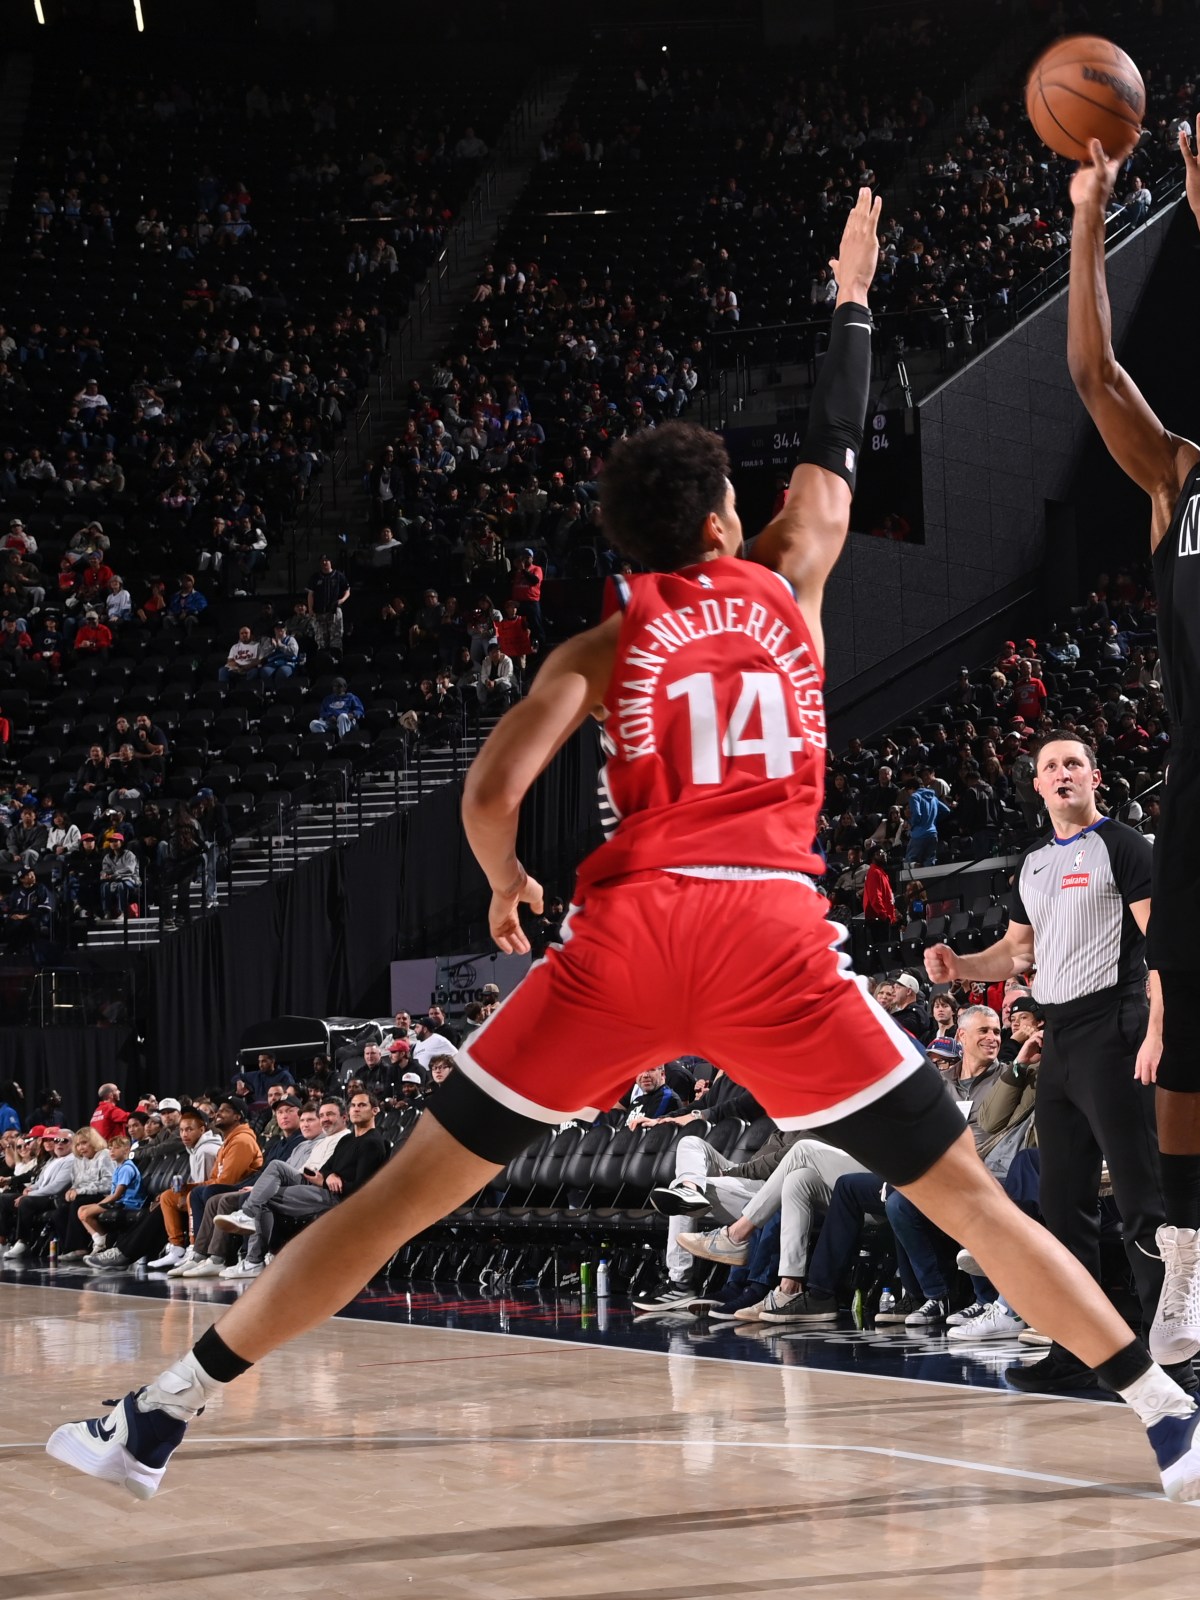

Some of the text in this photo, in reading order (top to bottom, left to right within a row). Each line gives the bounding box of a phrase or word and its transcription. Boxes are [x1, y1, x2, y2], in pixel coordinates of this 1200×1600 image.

[774, 432, 800, 450] 34.4
[872, 434, 889, 450] 84
[618, 598, 827, 761] KONAN-NIEDERHAUSER
[666, 672, 803, 784] 14
[1062, 876, 1088, 886] Emirates
[431, 989, 482, 1005] LOCKTO
